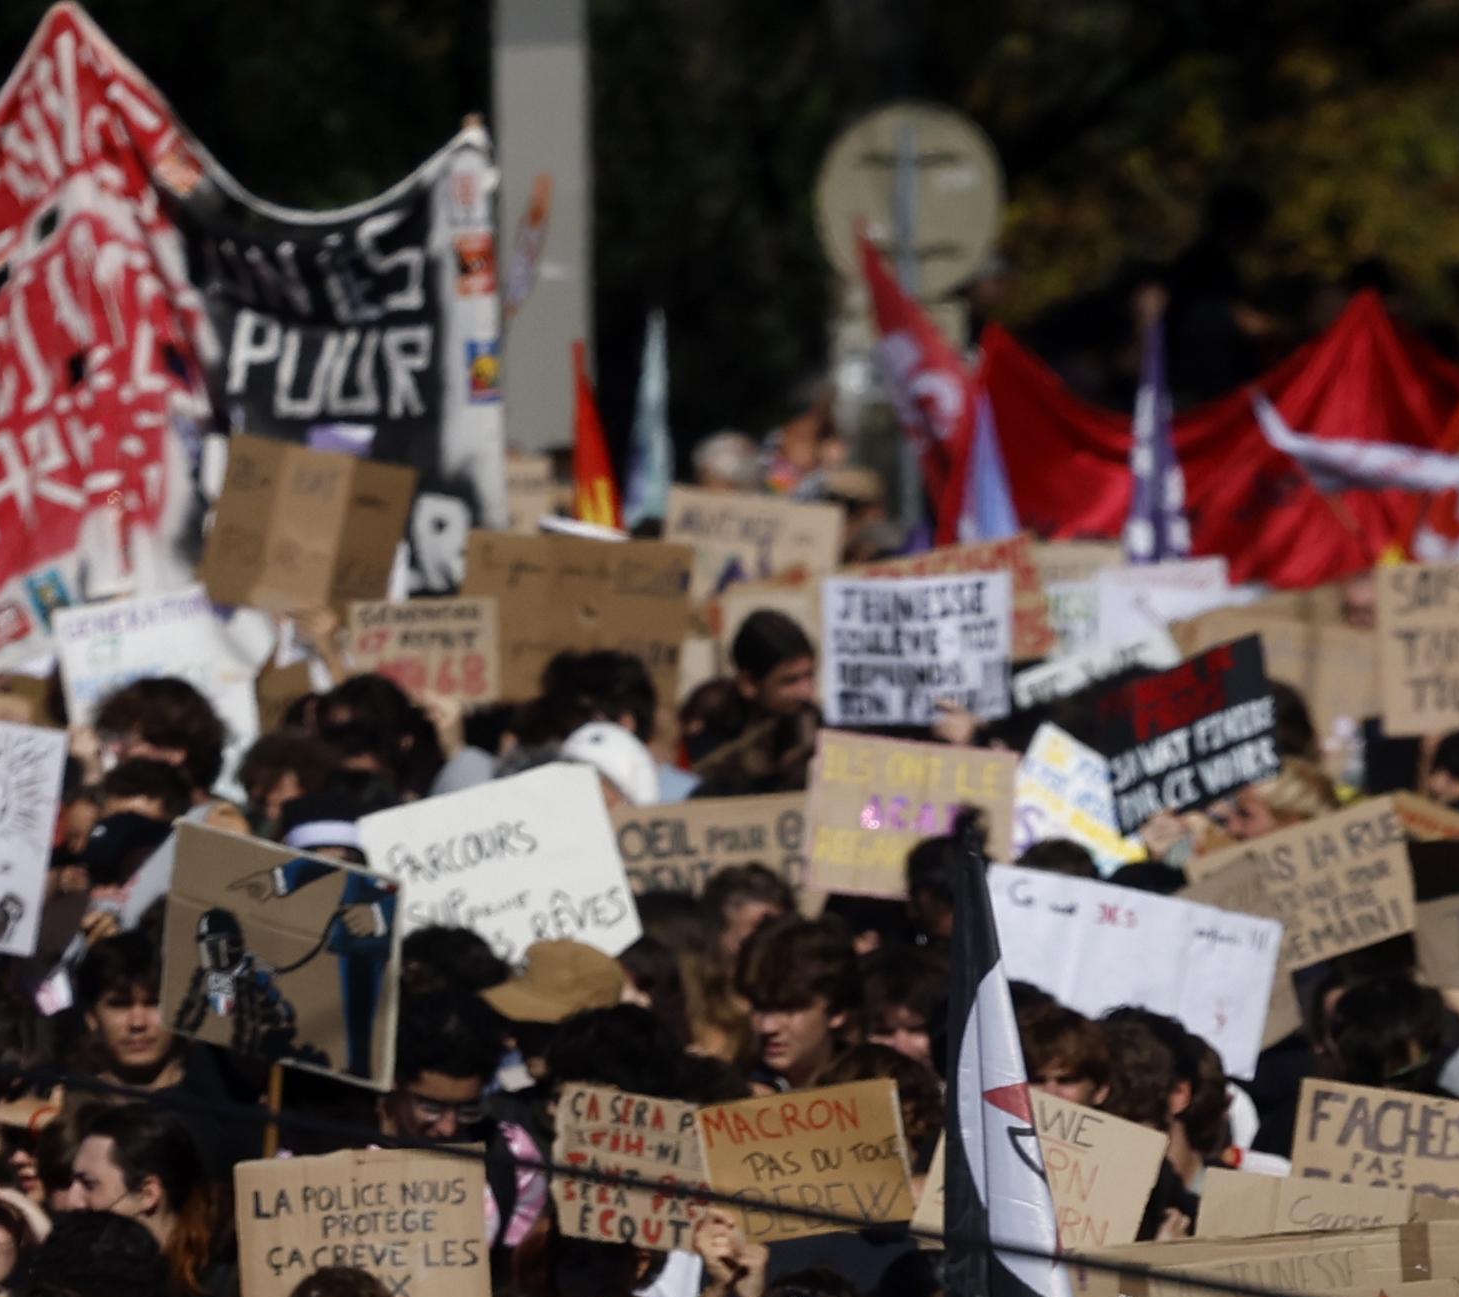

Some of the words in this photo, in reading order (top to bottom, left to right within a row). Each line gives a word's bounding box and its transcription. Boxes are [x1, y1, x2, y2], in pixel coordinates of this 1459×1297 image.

[388, 822, 537, 878] PARCOURS
[702, 1099, 862, 1151] MACRON
[743, 1149, 802, 1181] PAS
[1351, 1153, 1406, 1179] PAS
[252, 1190, 292, 1220] LA
[399, 1177, 466, 1206] NOUS
[420, 1236, 481, 1270] LES
